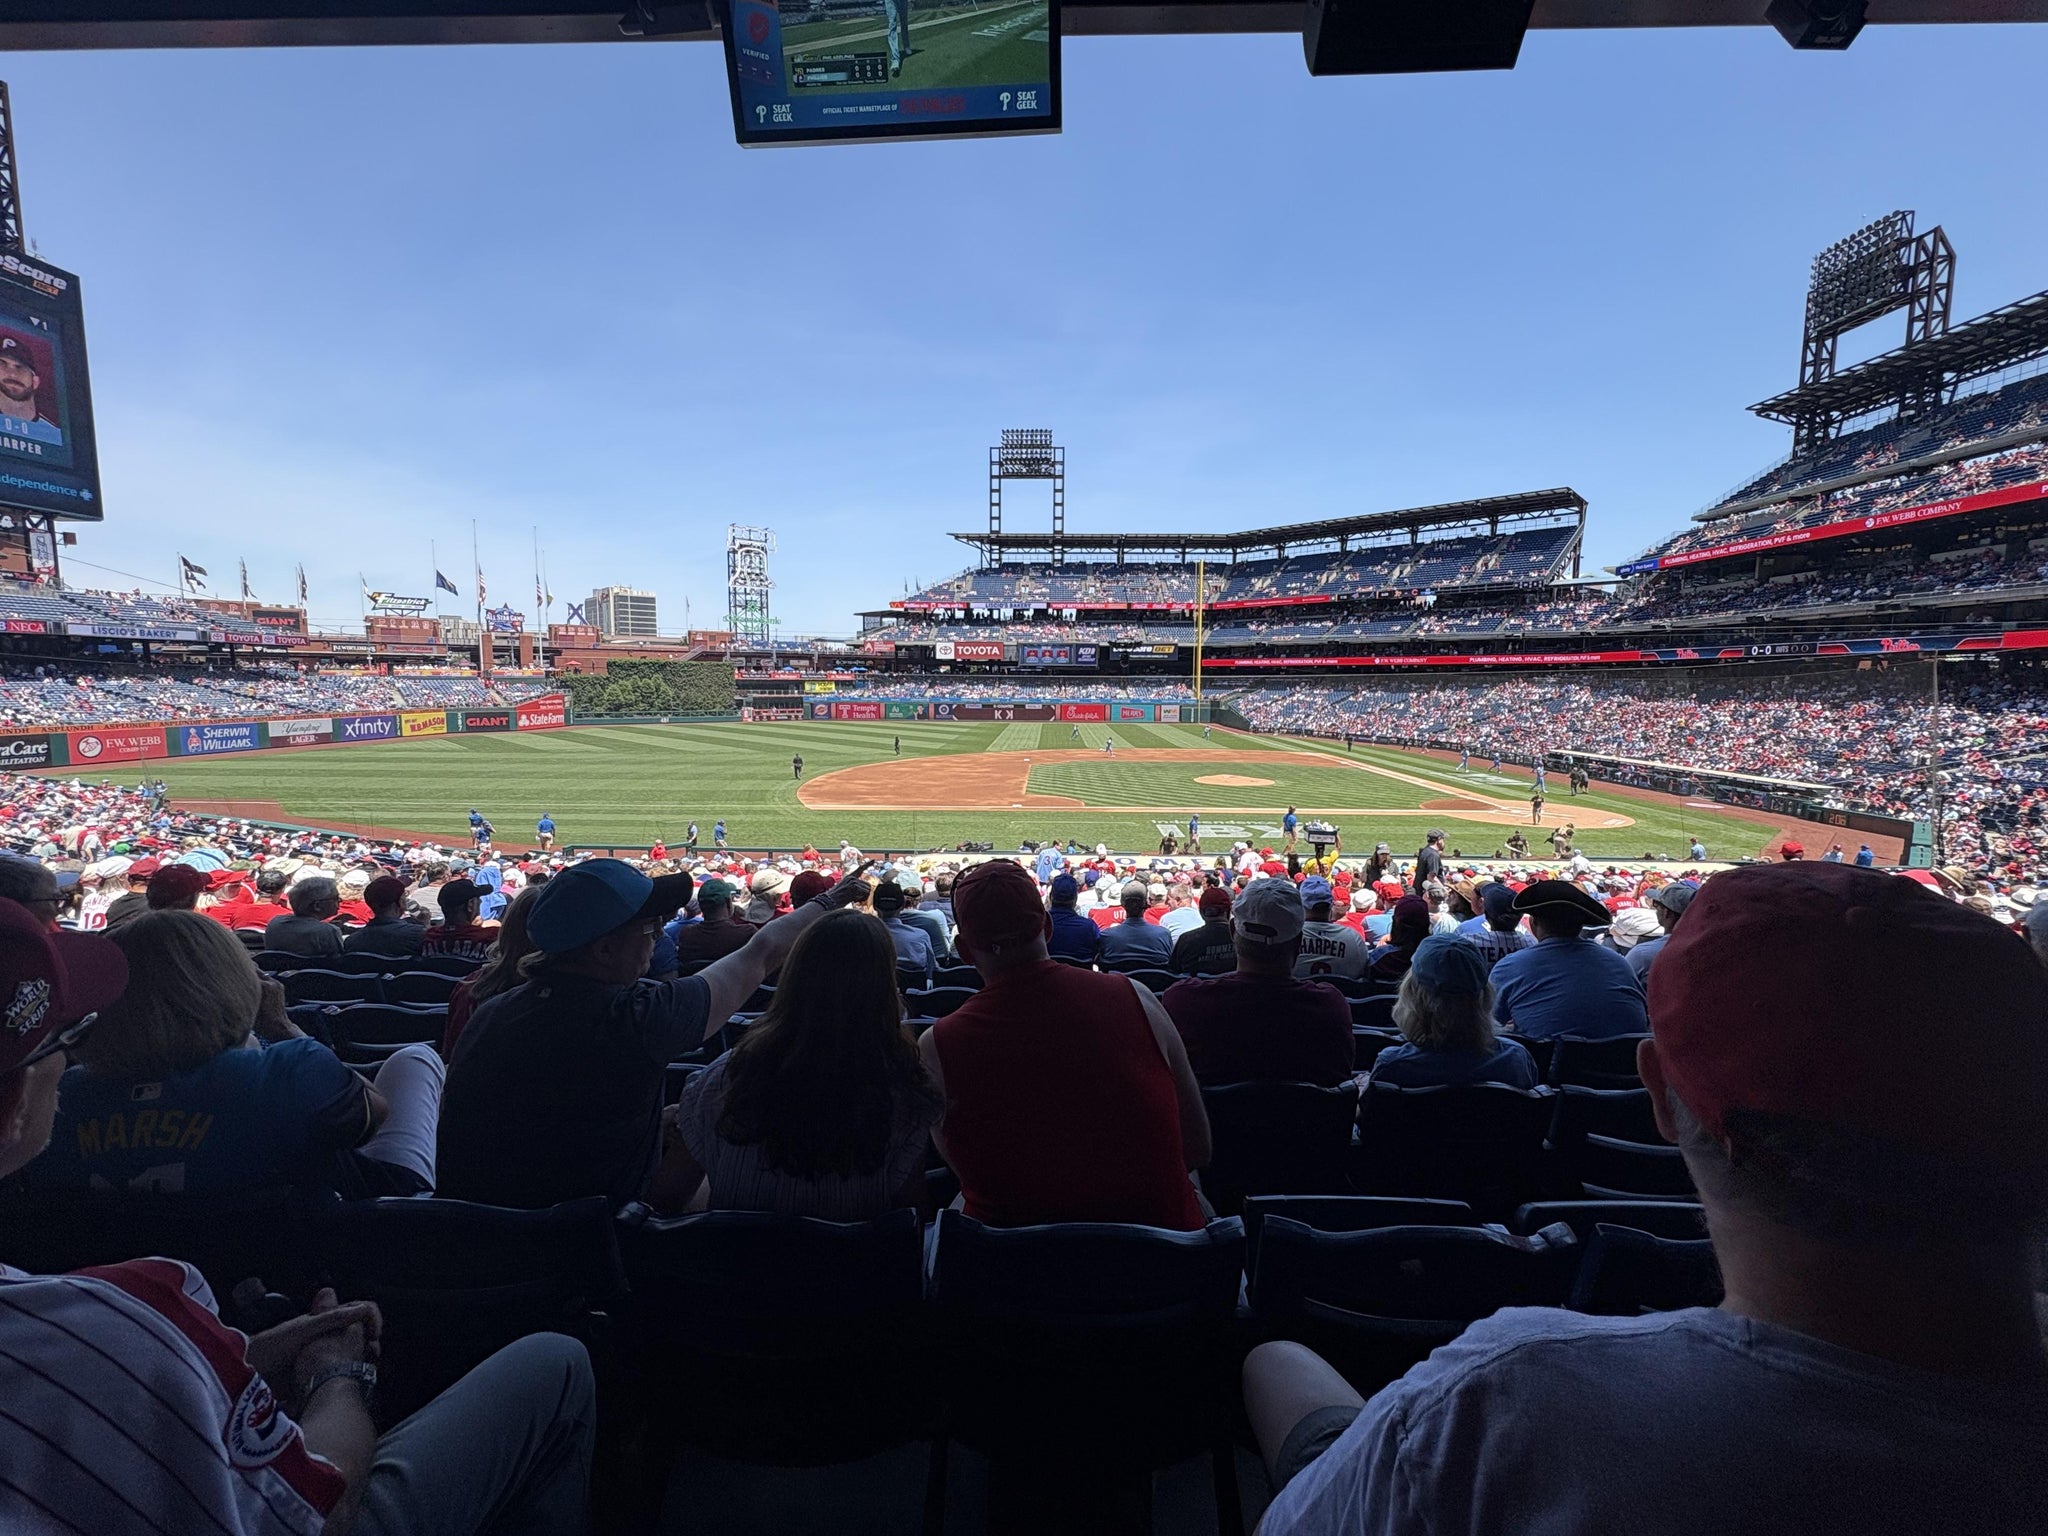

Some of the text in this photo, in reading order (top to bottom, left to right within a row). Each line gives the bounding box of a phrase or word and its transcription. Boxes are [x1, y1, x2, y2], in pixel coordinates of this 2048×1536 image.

[742, 48, 770, 60] VERIFIED
[1017, 91, 1036, 100] SEAT
[772, 104, 791, 113] SEAT
[1017, 100, 1037, 110] GEEK
[772, 113, 793, 122] GEEK
[1892, 510, 1916, 522] WEBB
[1918, 502, 1962, 517] COMPANY
[1690, 552, 1711, 561] HEATING,
[1712, 548, 1728, 557] HVAC,
[1729, 540, 1773, 553] REFRIGERATION,
[1793, 532, 1810, 541] more
[376, 592, 425, 605] Fitzpatrick
[10, 622, 45, 632] NECA
[91, 627, 177, 638] LISCIO'S BAKERY
[227, 634, 260, 643] TOYOTA
[276, 636, 306, 645] TOYOTA
[956, 646, 1000, 655] TOYOTA
[1752, 646, 1772, 655] 0-0
[995, 710, 1002, 719] K
[466, 717, 509, 726] GIANT
[203, 727, 250, 738] SHERWIN
[282, 722, 322, 734] Yuengling
[345, 719, 391, 737] xfinity
[106, 736, 161, 748] F.W. WEBB
[1044, 856, 1050, 865] 3
[1300, 938, 1345, 958] HARPER
[6, 980, 45, 1017] WORLD
[19, 1001, 50, 1036] SERIES
[76, 1110, 215, 1159] MARSH
